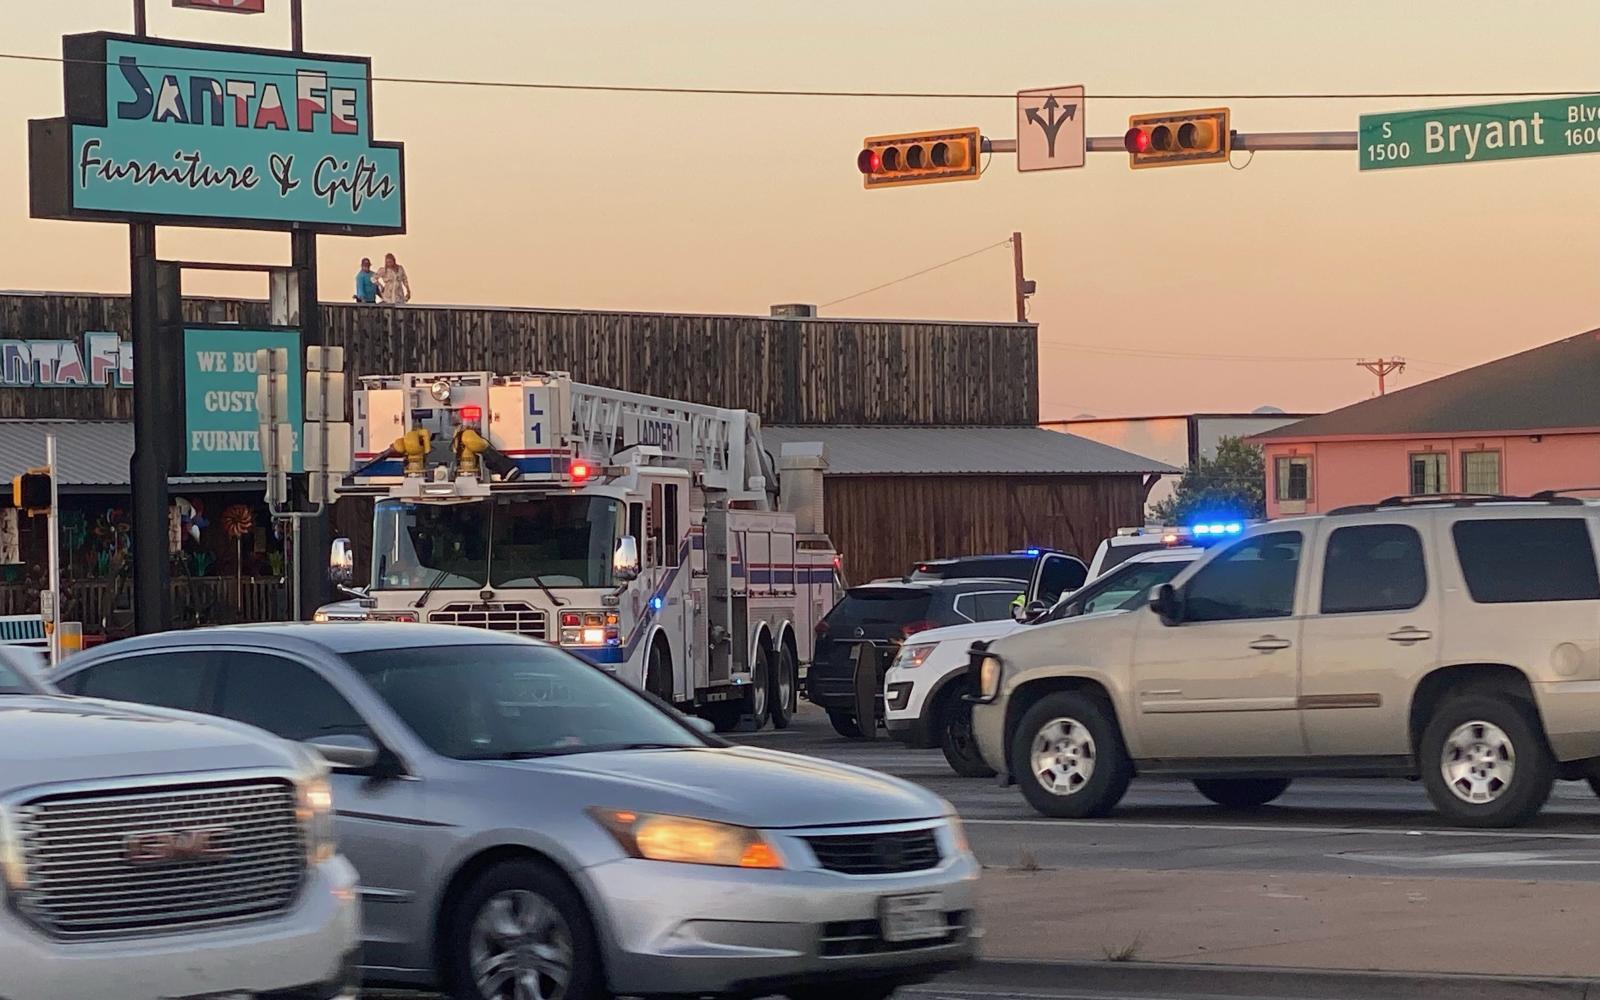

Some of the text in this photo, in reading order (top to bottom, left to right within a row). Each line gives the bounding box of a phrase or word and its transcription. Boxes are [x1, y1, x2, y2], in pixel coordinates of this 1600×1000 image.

[1568, 104, 1600, 123] Blv
[1382, 122, 1392, 139] S
[1425, 112, 1544, 160] Bryant
[1367, 143, 1410, 161] 1500
[80, 139, 396, 212] Furniture & Gifts
[197, 351, 258, 373] WE BU
[205, 390, 259, 412] CUST
[637, 418, 673, 452] LADDER
